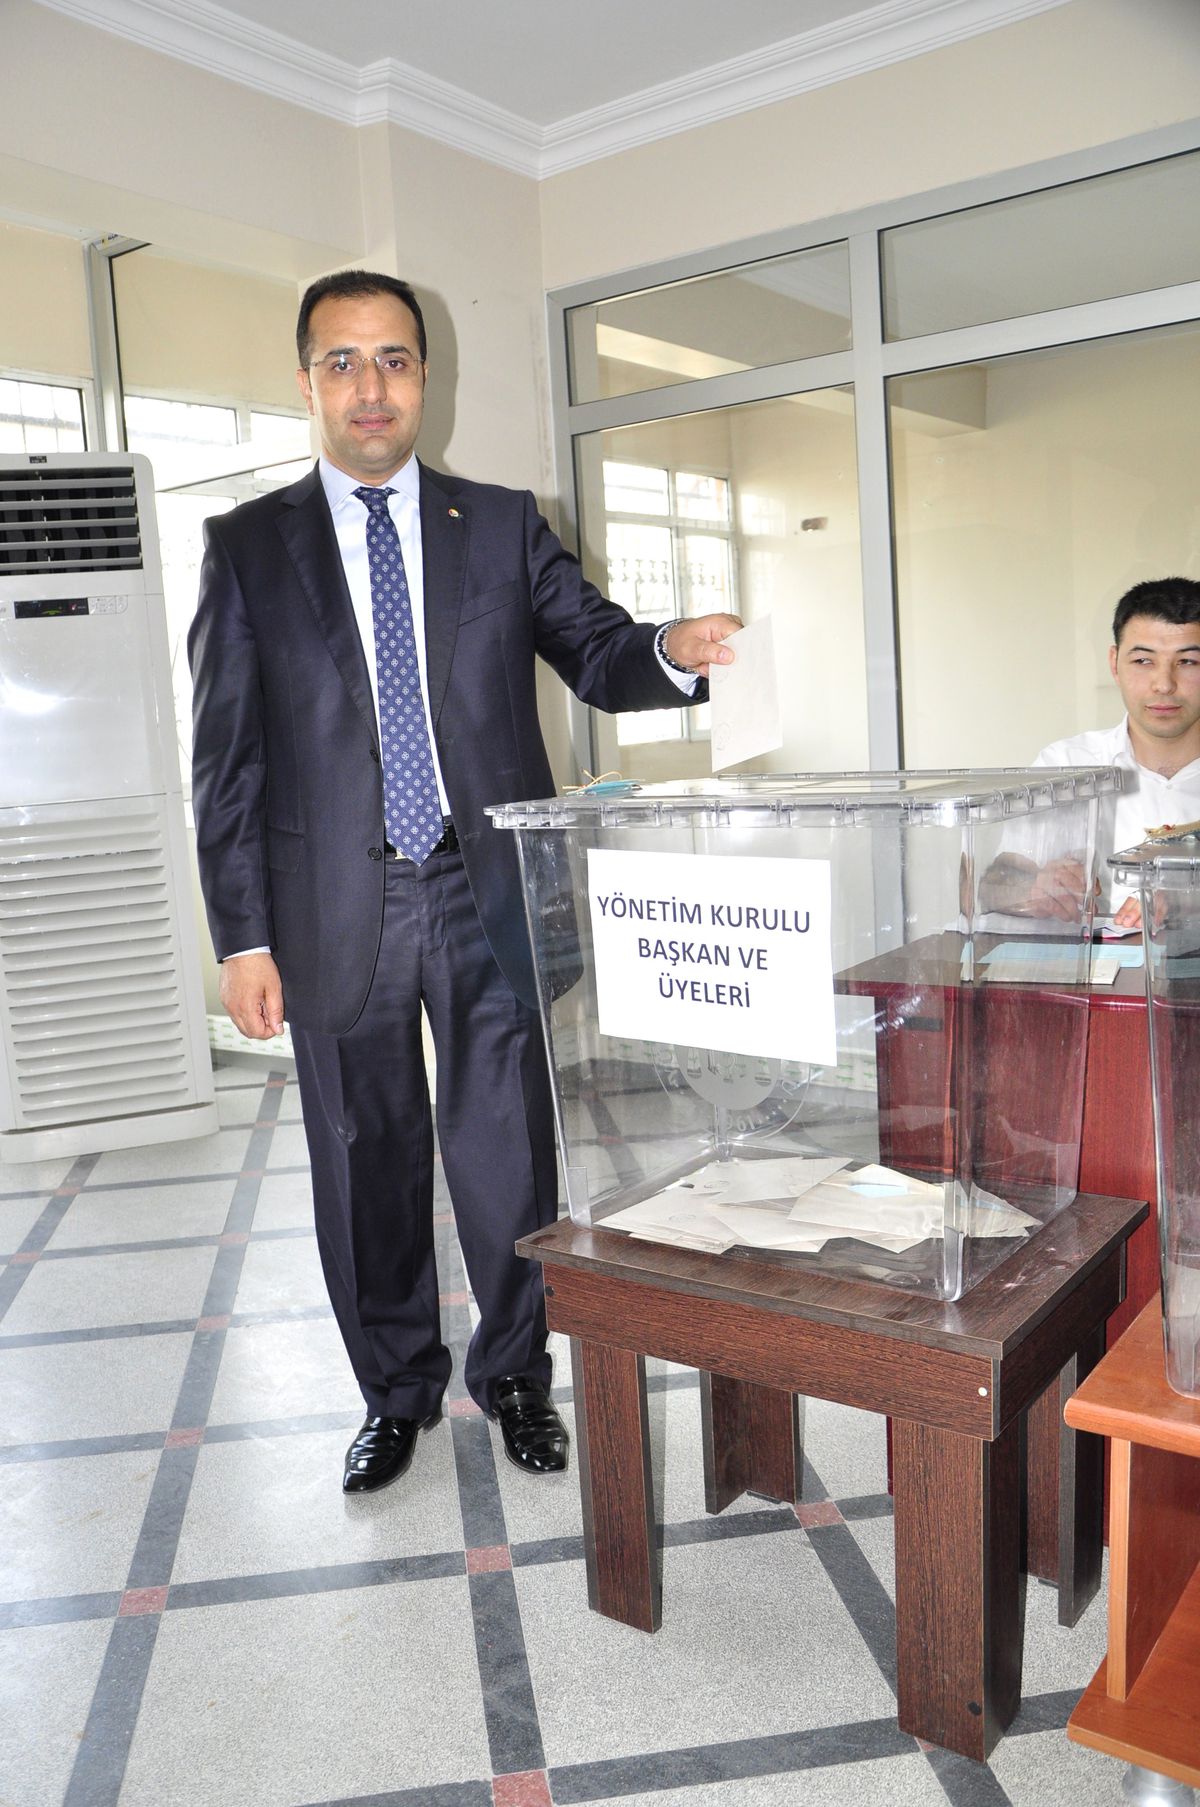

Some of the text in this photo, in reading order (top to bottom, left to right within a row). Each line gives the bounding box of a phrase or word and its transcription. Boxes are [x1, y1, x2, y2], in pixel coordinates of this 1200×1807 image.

[597, 891, 811, 934] YÖNETİM KURULU
[637, 937, 769, 972] BAŞKAN VE
[658, 972, 751, 1008] ÜYELERİ
